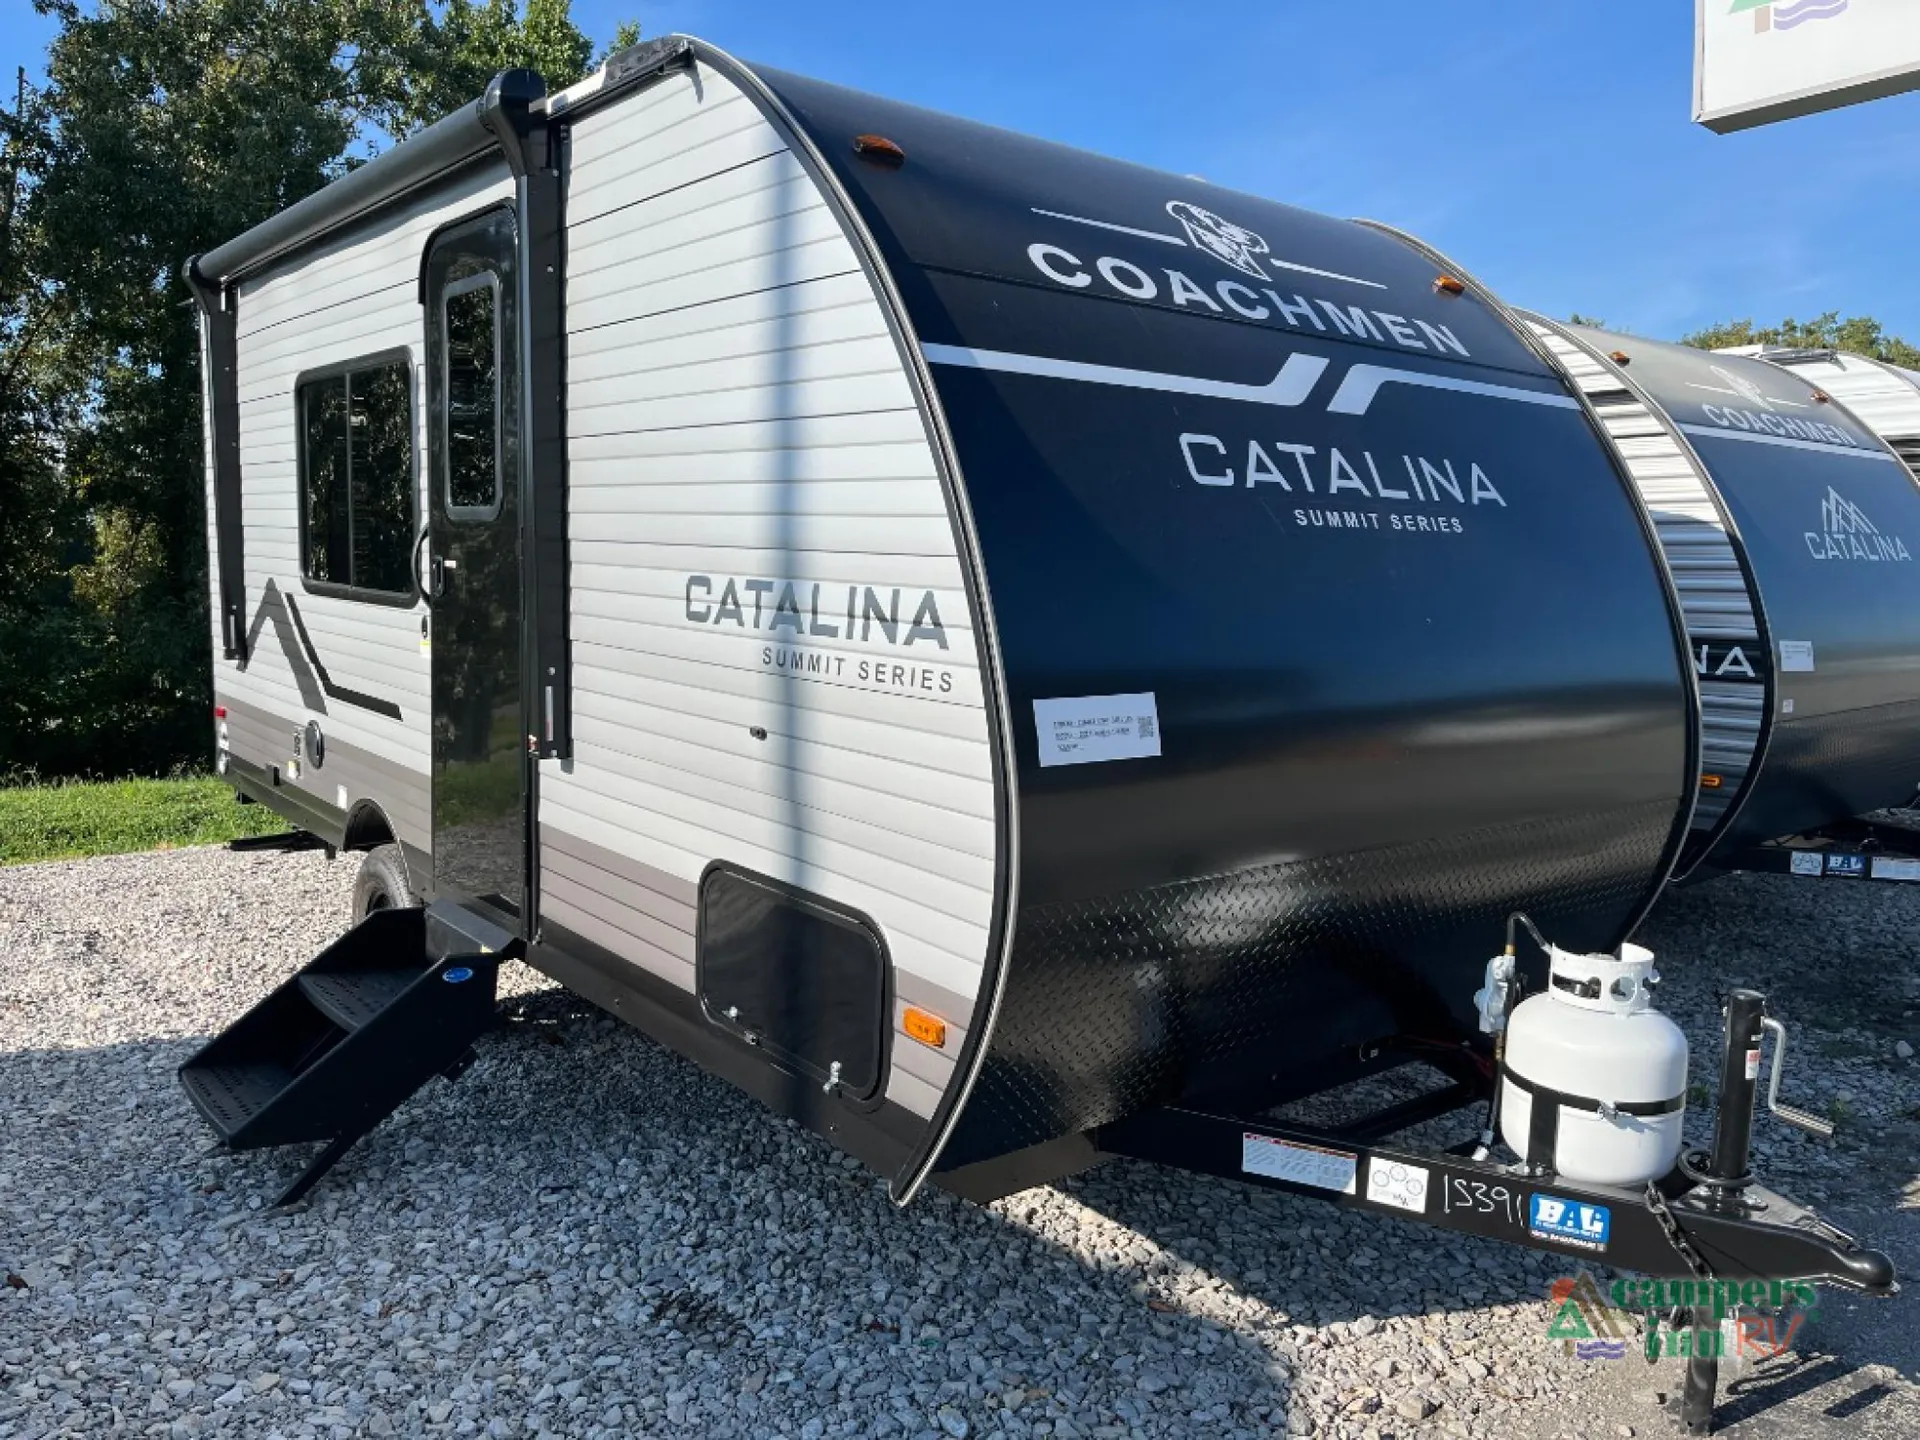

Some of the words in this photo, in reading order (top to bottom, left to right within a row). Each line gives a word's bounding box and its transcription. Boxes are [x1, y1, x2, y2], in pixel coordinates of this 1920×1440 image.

[1027, 243, 1470, 357] COACHMEN
[1702, 403, 1858, 446] COACHMEN
[1179, 432, 1508, 508] CATALINA
[1293, 508, 1380, 530] SUMMIT
[1390, 512, 1464, 534] SERIES
[1804, 532, 1913, 562] CATALINA
[685, 575, 950, 651] CATALINA
[762, 646, 847, 677] SUMMIT
[858, 660, 953, 693] SERIES
